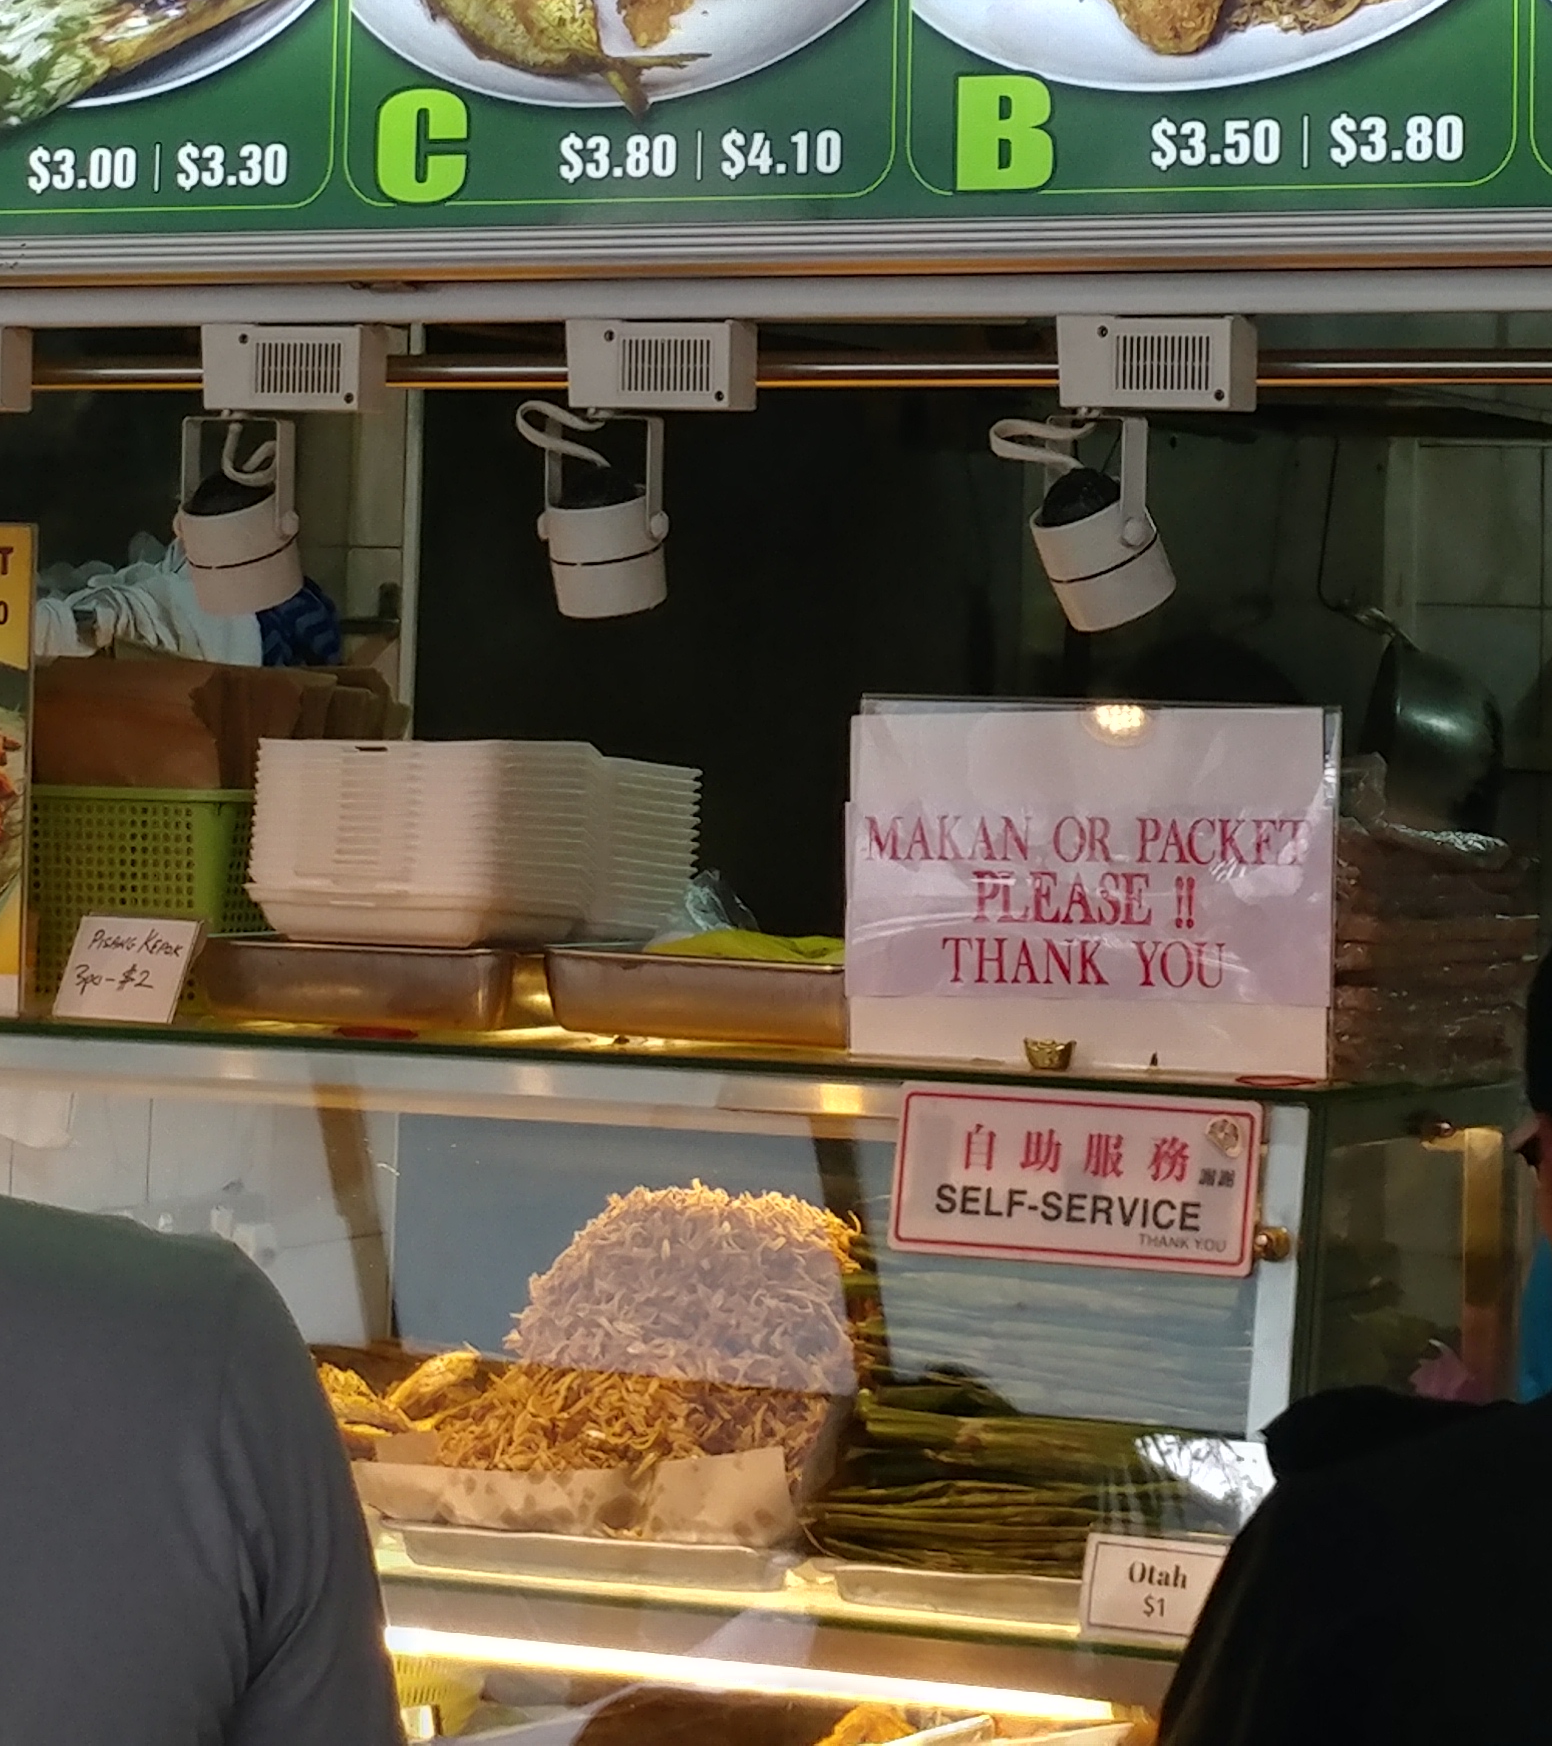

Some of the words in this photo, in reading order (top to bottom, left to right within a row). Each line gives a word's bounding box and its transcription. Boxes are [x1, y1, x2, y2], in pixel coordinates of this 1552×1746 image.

[375, 86, 470, 205] C
[558, 131, 678, 184] $3.80
[719, 127, 844, 180] $4.10
[953, 73, 1055, 194] B
[1149, 117, 1283, 171] $3.50
[1328, 113, 1466, 167] $3.80
[27, 146, 138, 194] $3.00
[175, 141, 289, 191] $3.30
[863, 815, 1032, 863] MAKAN
[1052, 815, 1114, 863] OR
[971, 869, 1153, 927] PLEASE
[942, 936, 1110, 986] THANK
[1132, 940, 1227, 989] YOU
[962, 1122, 1193, 1185] 自助服務
[934, 1183, 1202, 1233] SELF-SERVICE
[1138, 1232, 1190, 1250] THANK
[1194, 1237, 1228, 1253] YOU
[1127, 1559, 1189, 1591] Otah
[1142, 1594, 1166, 1619] $1
